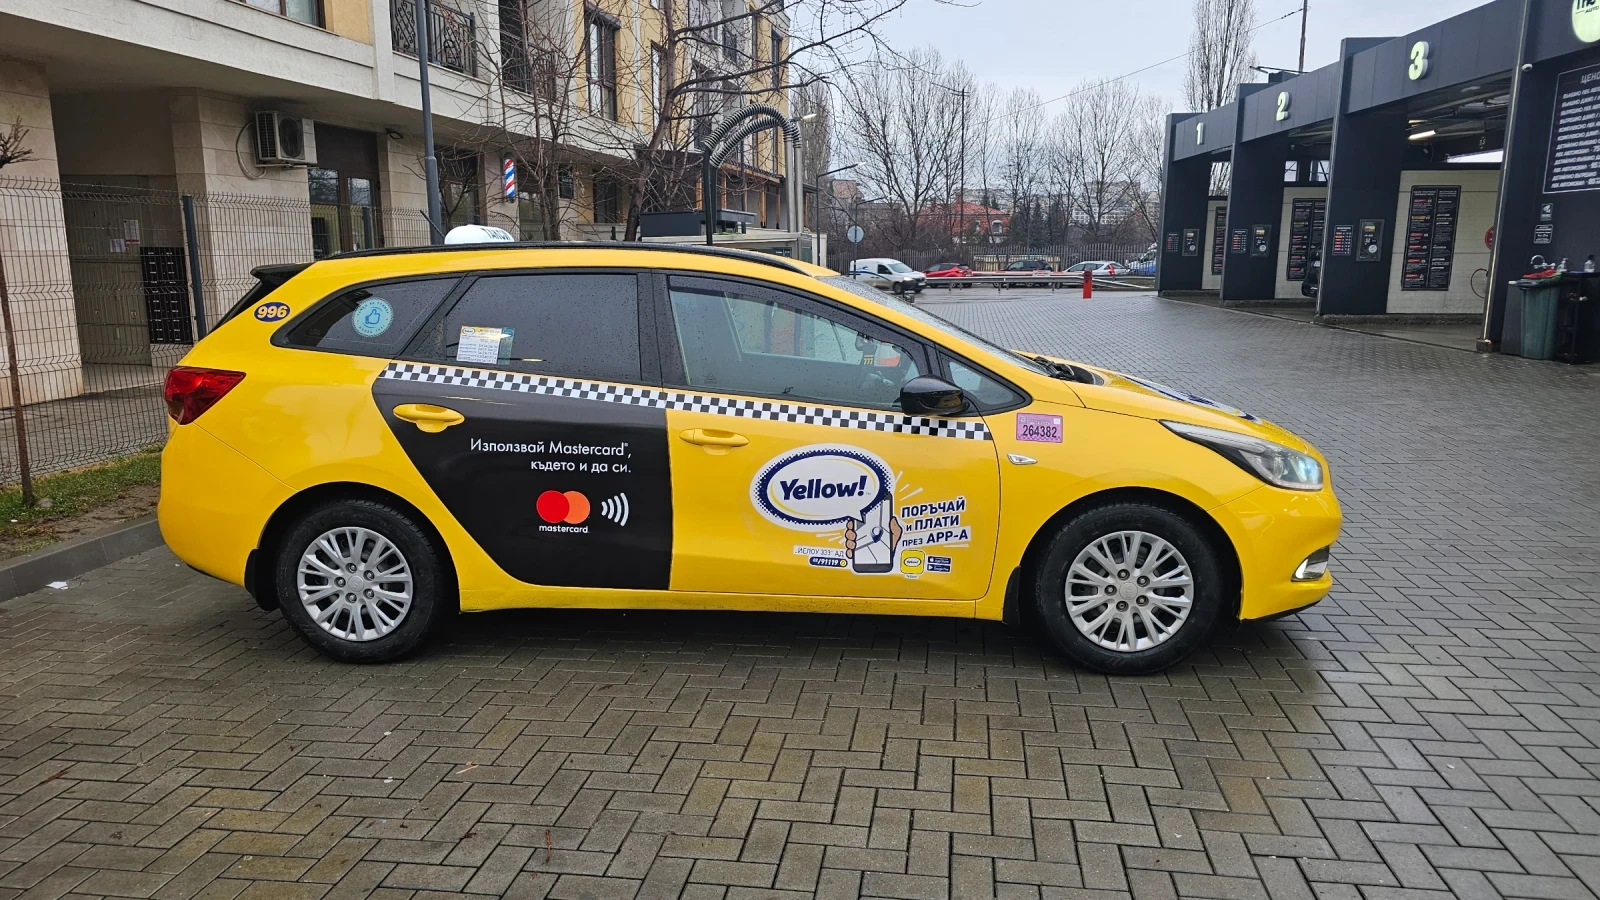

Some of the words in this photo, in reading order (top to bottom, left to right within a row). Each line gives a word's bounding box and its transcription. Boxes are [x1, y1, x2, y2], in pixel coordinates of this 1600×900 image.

[1408, 41, 1429, 81] 3
[1276, 91, 1290, 121] 2
[1196, 122, 1204, 145] 1
[257, 305, 288, 319] 996
[1022, 424, 1057, 438] 264382
[470, 437, 545, 453] Използвай
[530, 460, 575, 472] където
[579, 462, 588, 471] и
[591, 463, 608, 473] да
[612, 464, 632, 473] си.
[780, 475, 867, 500] Yellow!
[901, 496, 965, 518] ПОРЪЧАЙ
[538, 524, 589, 534] mastercard
[915, 514, 959, 530] ПЛАТИ
[902, 537, 923, 547] ПРЕЗ
